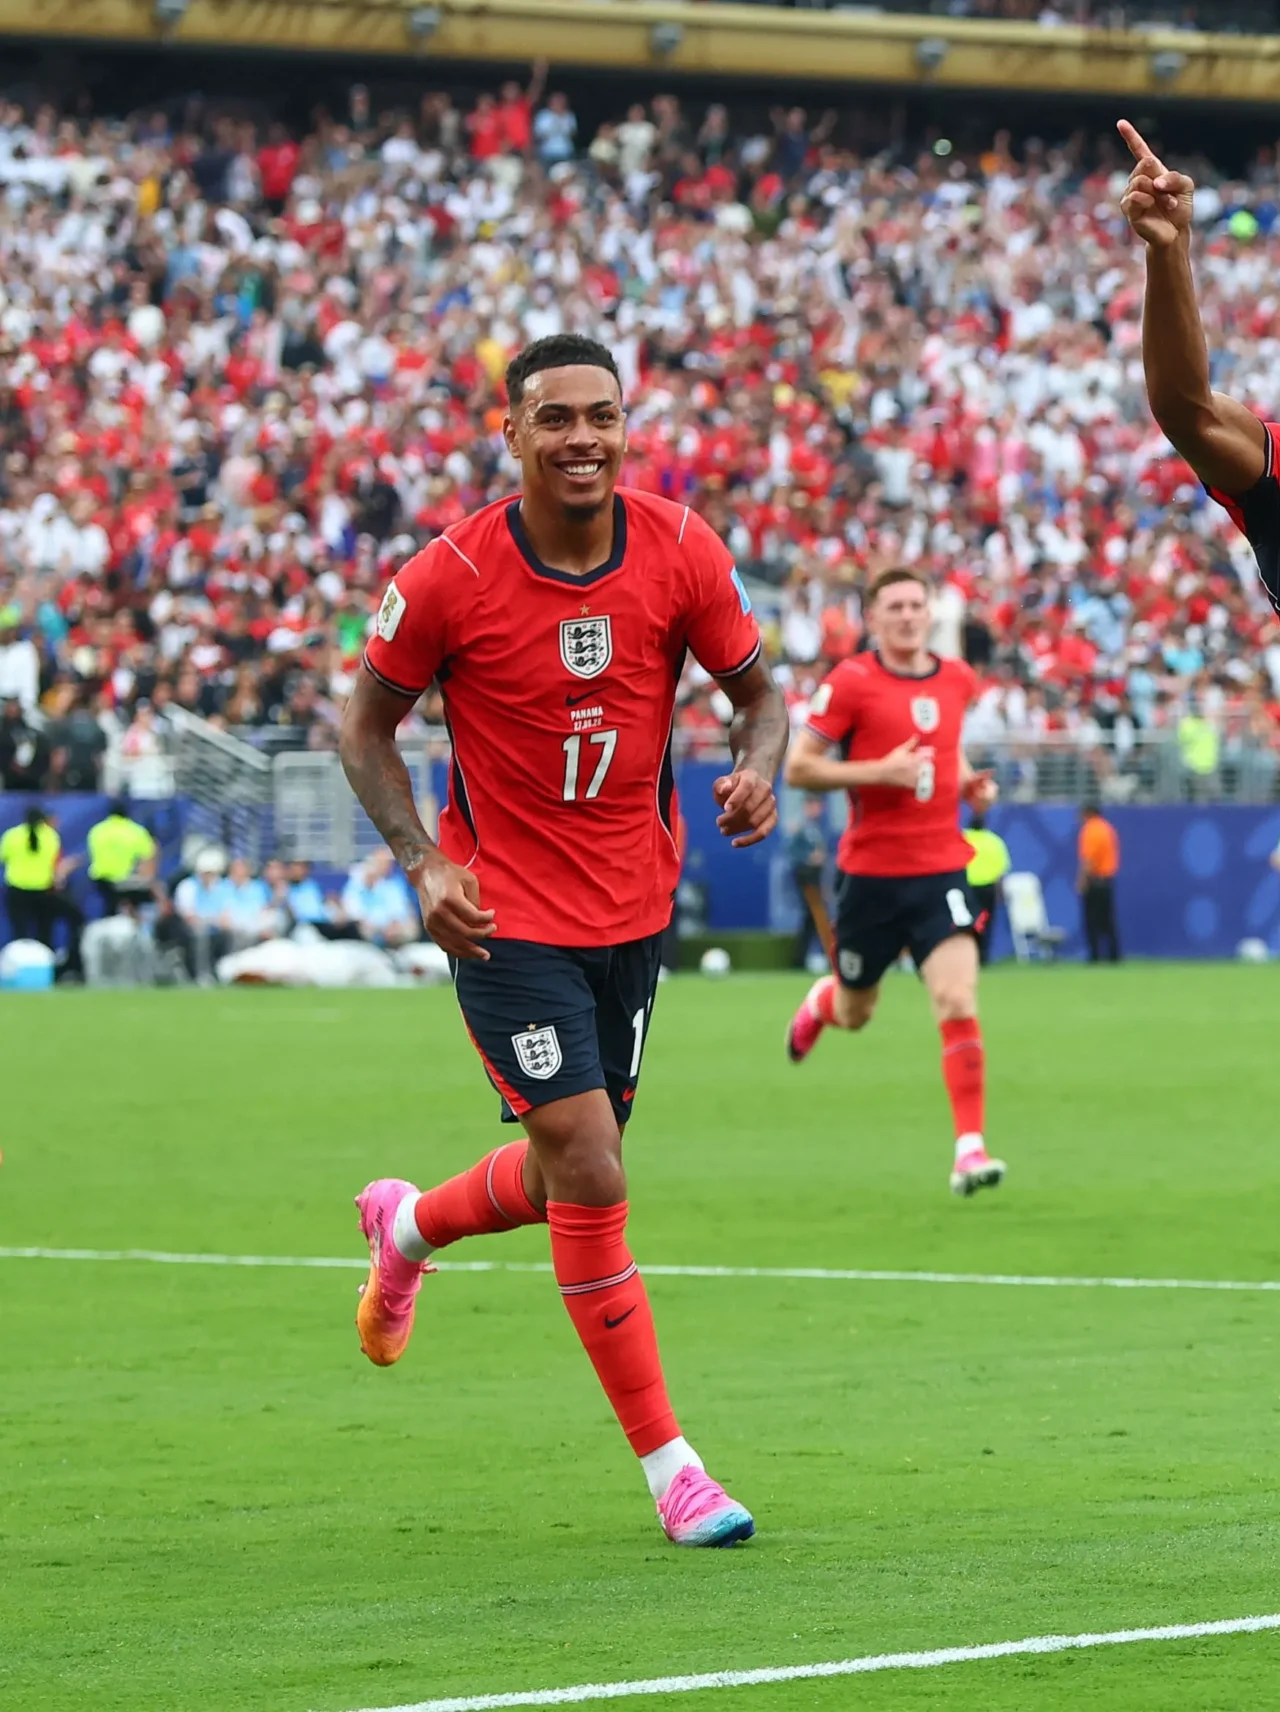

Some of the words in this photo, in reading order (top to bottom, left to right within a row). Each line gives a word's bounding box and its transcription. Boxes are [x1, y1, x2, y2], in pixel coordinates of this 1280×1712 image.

[570, 705, 604, 721] PANAMA
[562, 729, 618, 802] 17
[629, 996, 652, 1079] 1
